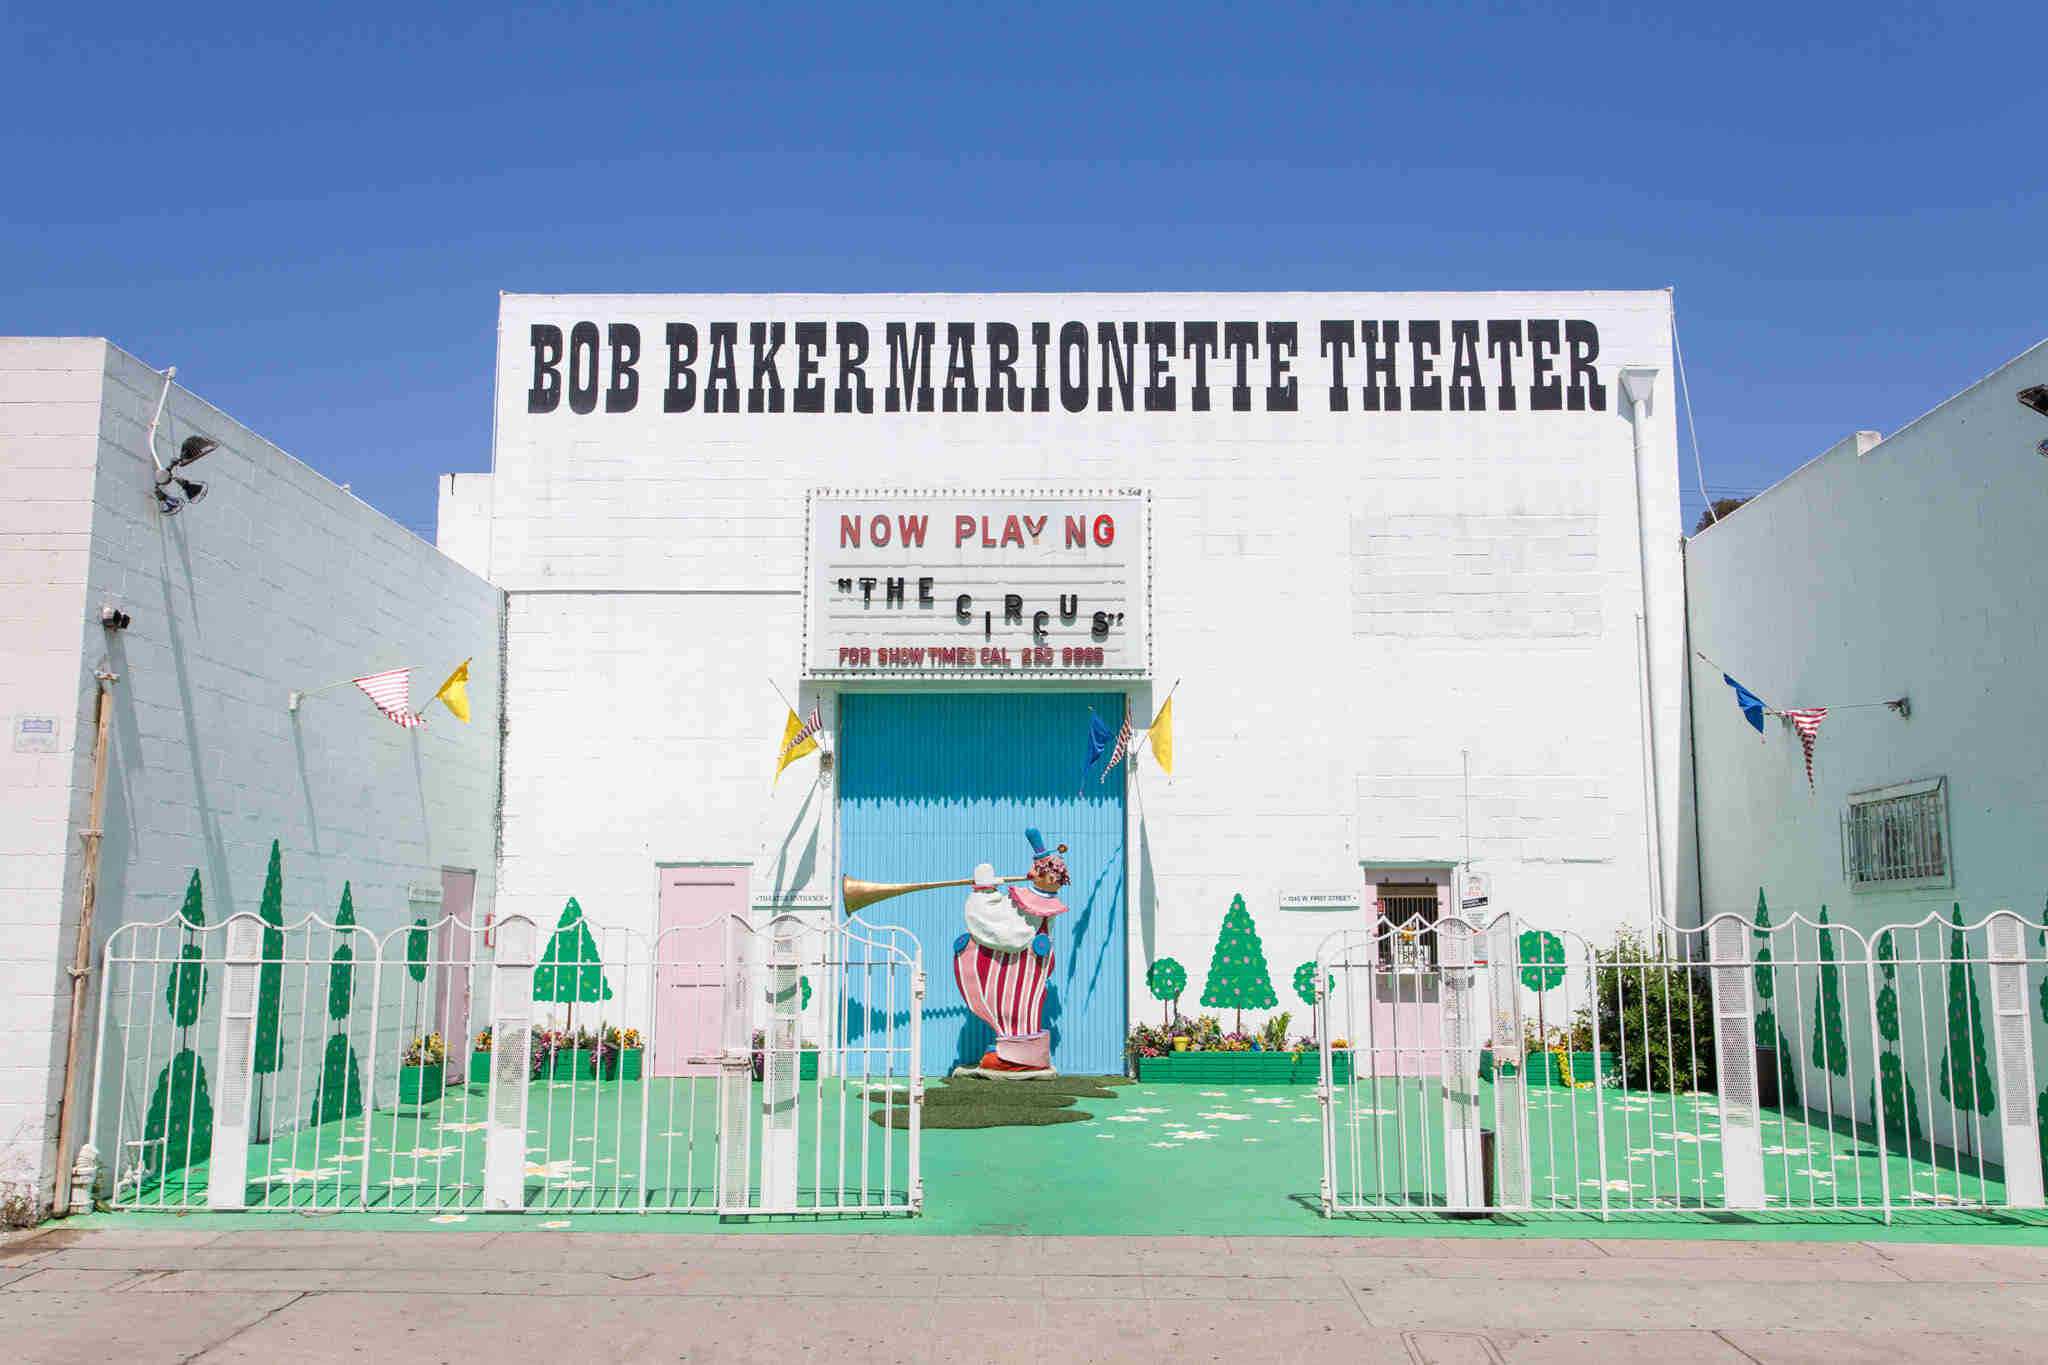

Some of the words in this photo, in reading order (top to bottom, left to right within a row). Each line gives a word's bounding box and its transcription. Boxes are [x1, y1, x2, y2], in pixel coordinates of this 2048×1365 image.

[527, 321, 641, 415] BOB
[663, 321, 874, 414] BAKER
[885, 321, 1298, 413] MARIONETTE
[1320, 319, 1606, 412] THEATER
[840, 514, 928, 548] NOW
[839, 647, 872, 667] FOR
